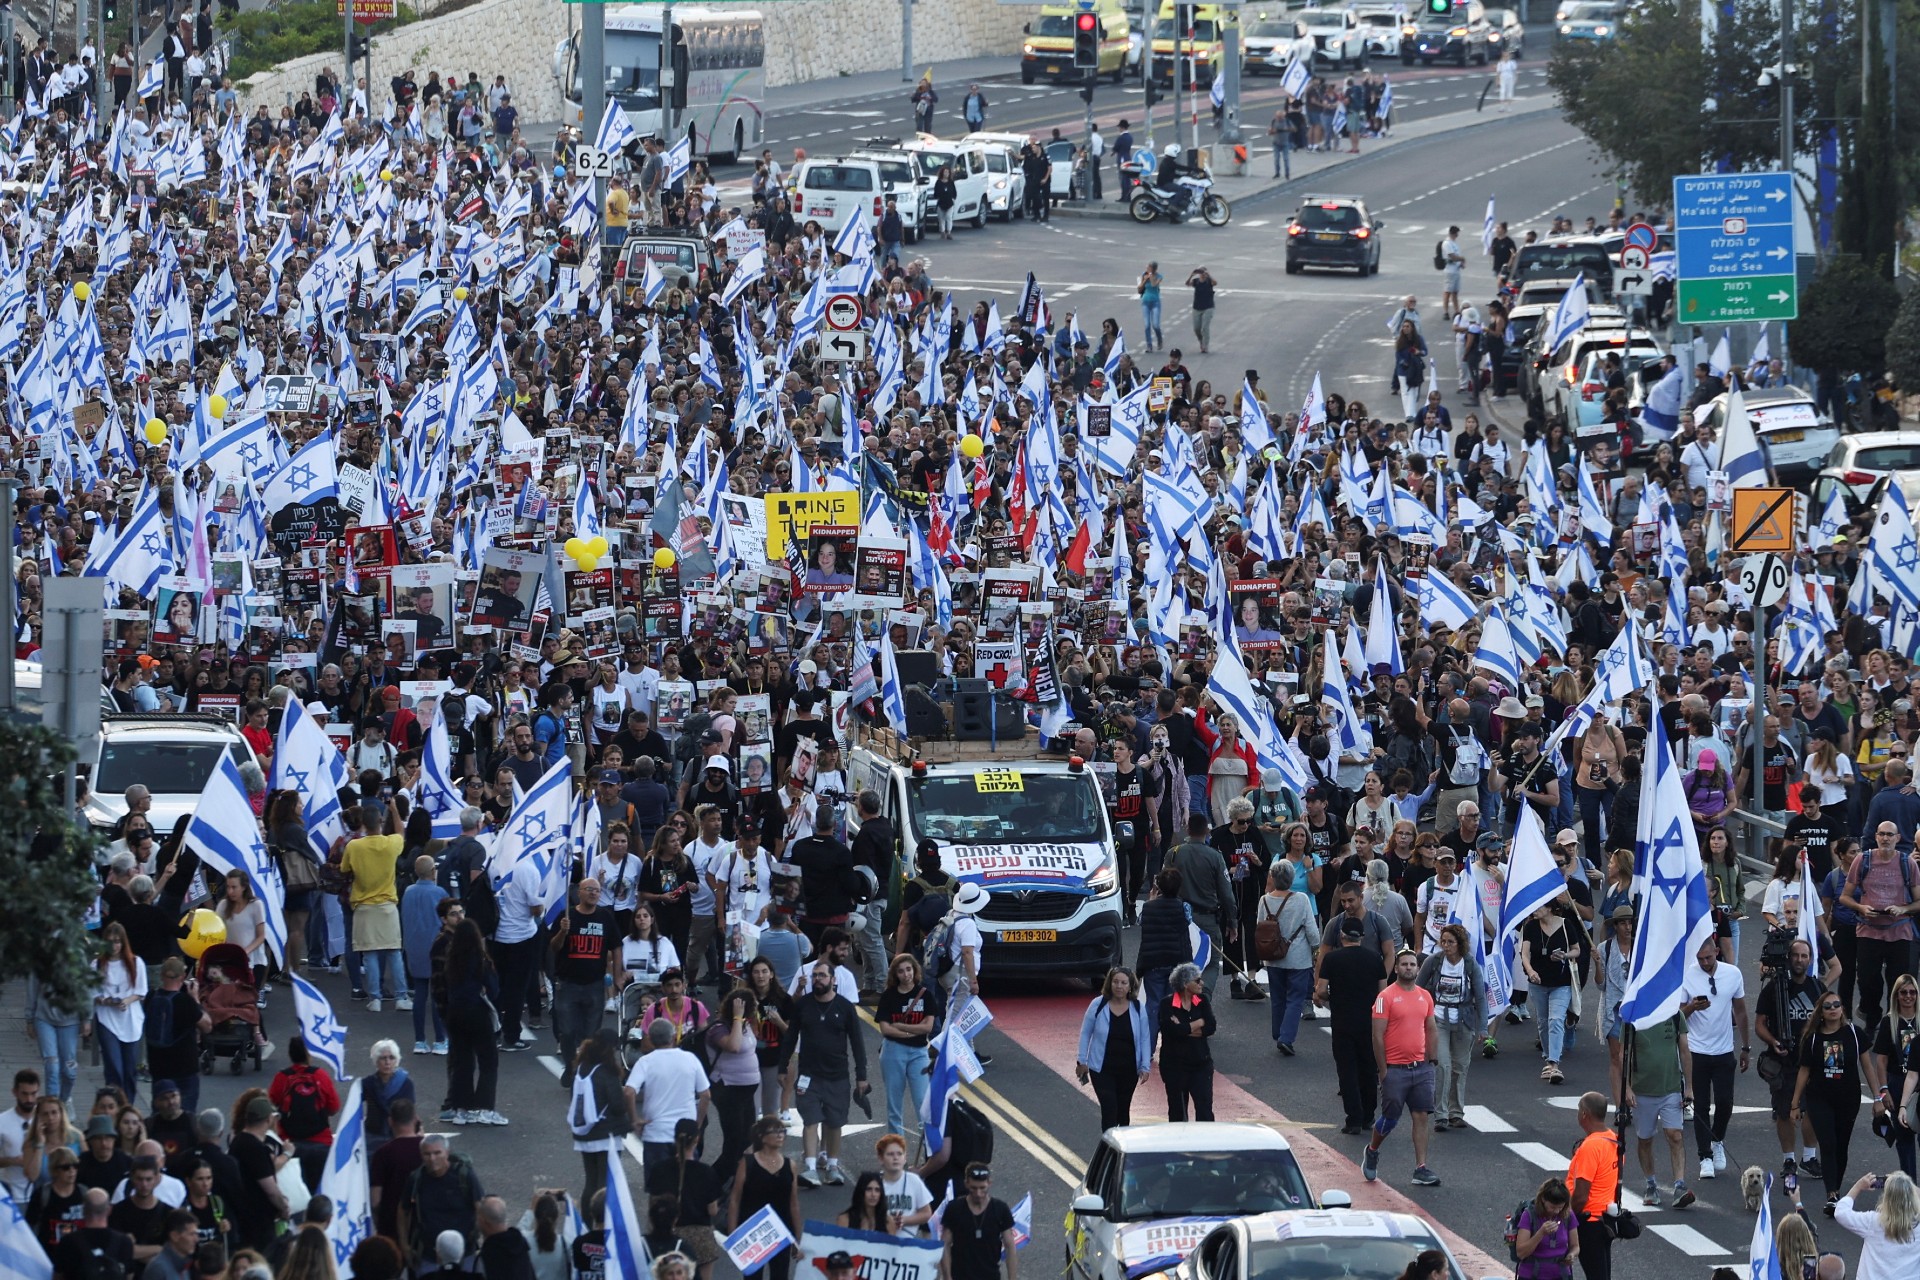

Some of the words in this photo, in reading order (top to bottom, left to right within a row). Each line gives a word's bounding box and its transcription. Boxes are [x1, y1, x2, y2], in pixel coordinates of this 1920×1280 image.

[338, 2, 364, 12] האום
[579, 152, 609, 171] 6.2
[1685, 181, 1725, 192] אדומים
[1729, 179, 1762, 190] מעלה
[1681, 207, 1717, 217] Ma'ale
[1722, 205, 1767, 215] Adumim
[1711, 238, 1744, 248] המלח
[1748, 237, 1761, 247] ים
[1709, 264, 1738, 273] Dead
[1742, 263, 1763, 271] Sea
[1724, 281, 1752, 292] רמות
[1720, 307, 1755, 316] Ramot
[304, 378, 311, 386] אל
[296, 401, 309, 410] לבד
[342, 464, 371, 486] BRING
[338, 478, 364, 498] HOME
[322, 506, 338, 517] אין
[494, 507, 513, 518] אבא
[778, 498, 846, 516] BRING
[293, 506, 316, 521] ניצחון
[865, 556, 886, 564] איתנו
[573, 578, 594, 586] איתנו
[1743, 565, 1786, 594] 30
[1233, 583, 1277, 591] KIDNAPPED
[976, 650, 993, 660] RED
[993, 649, 1012, 660] CRO
[1035, 662, 1058, 702] THEM
[984, 773, 1012, 781] רכב
[980, 781, 1020, 791] מלווה
[1274, 803, 1287, 812] SUR
[954, 845, 1003, 858] אותם
[1010, 844, 1085, 857] מחזירים
[957, 855, 1021, 871] עכשיו!
[1028, 856, 1088, 871] הביתה
[568, 935, 604, 954] עכשיו
[748, 1220, 773, 1243] מחזירים
[1146, 1223, 1206, 1240] אותם
[732, 1238, 748, 1256] אותם
